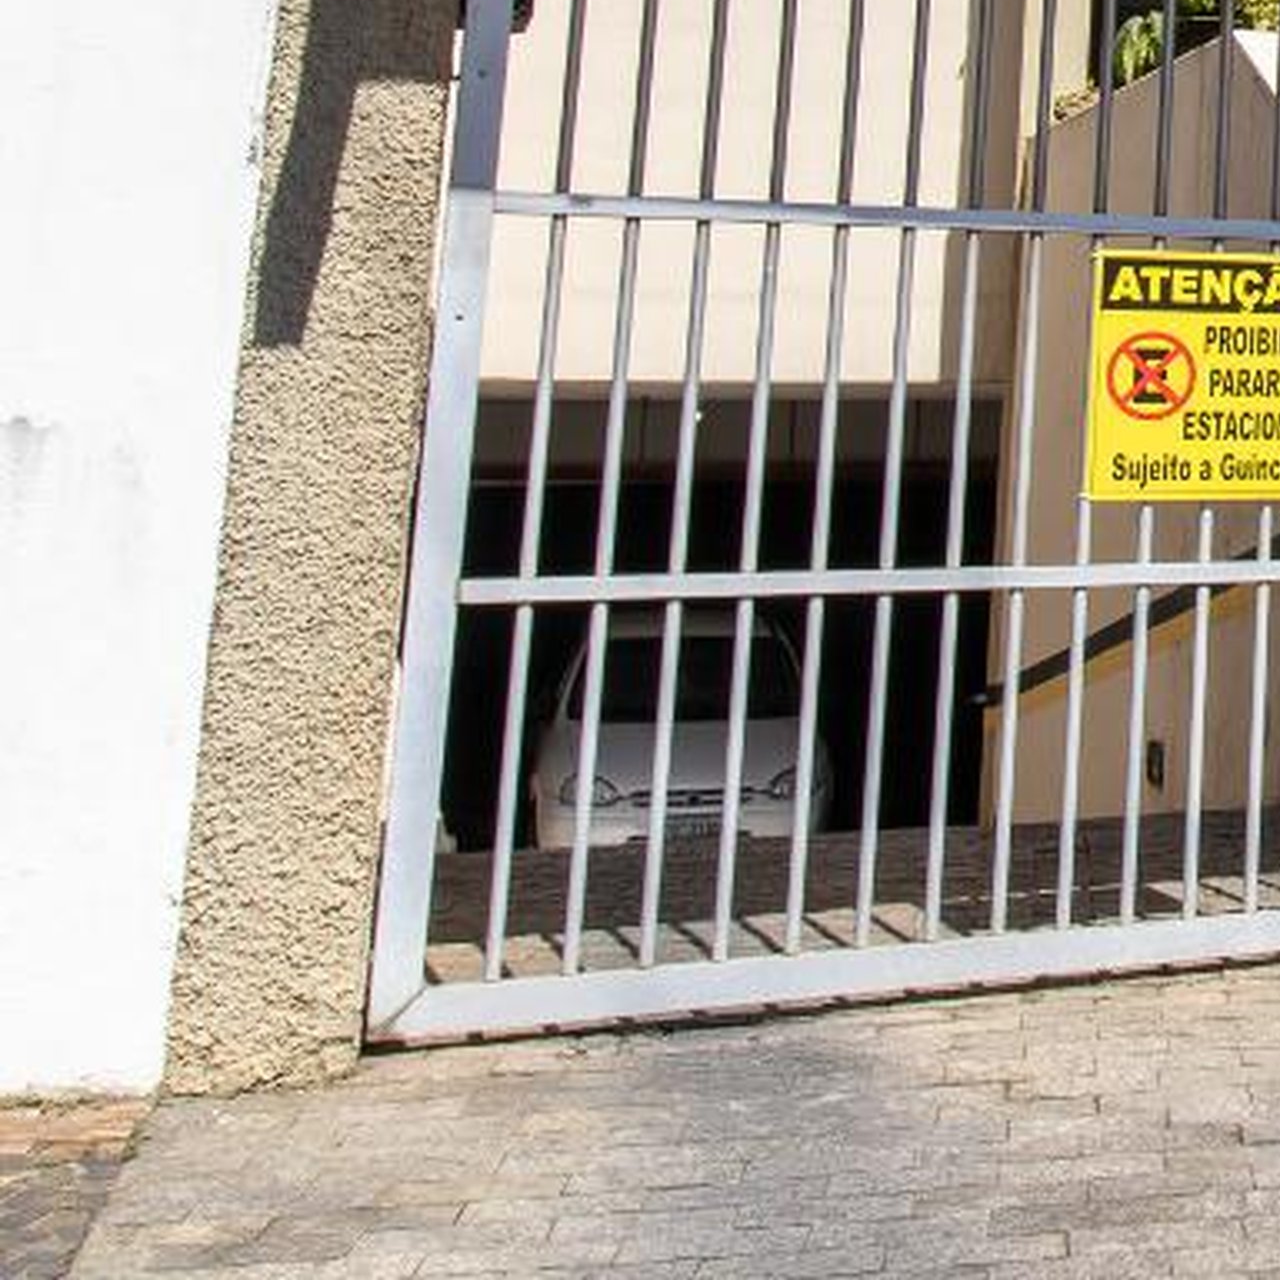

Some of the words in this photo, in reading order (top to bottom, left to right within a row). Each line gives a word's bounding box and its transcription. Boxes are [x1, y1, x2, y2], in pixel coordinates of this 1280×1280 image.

[1209, 369, 1280, 397] PARAR
[1112, 452, 1192, 489] Sujeito
[1199, 461, 1212, 481] a
